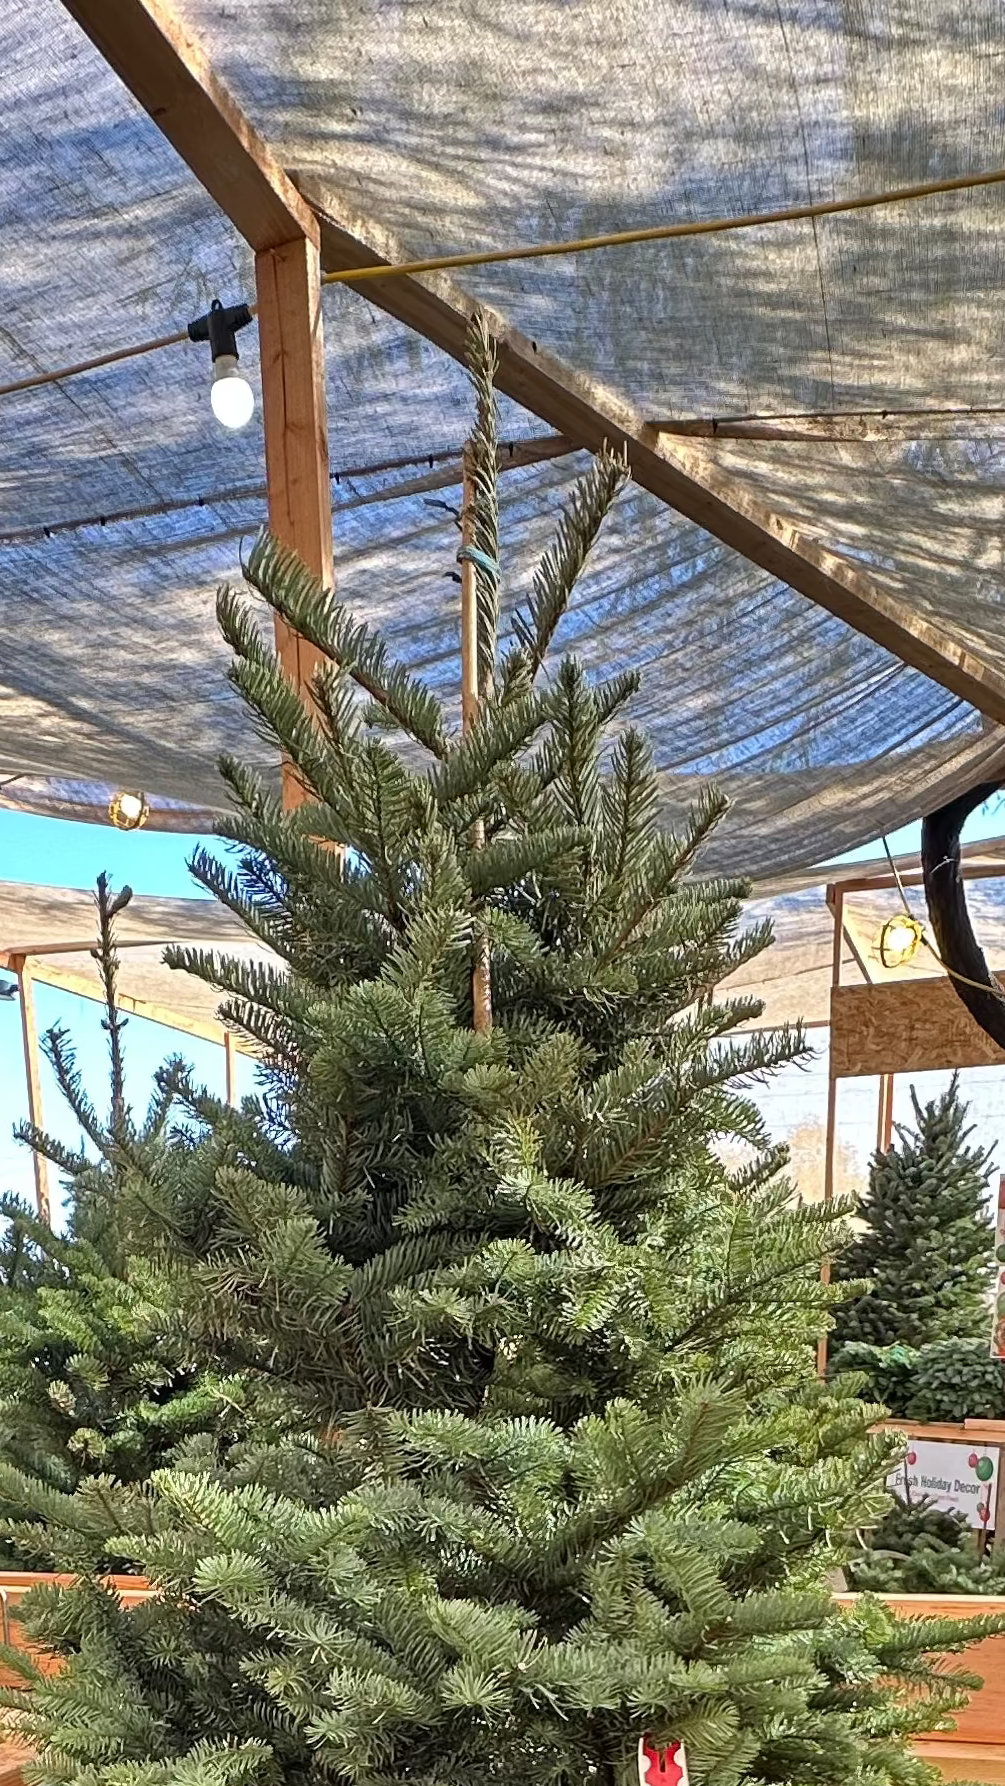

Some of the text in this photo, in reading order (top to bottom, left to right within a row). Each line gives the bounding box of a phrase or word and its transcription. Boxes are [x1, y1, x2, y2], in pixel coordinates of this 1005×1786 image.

[895, 1473, 980, 1494] Frsh Holiday Decor
